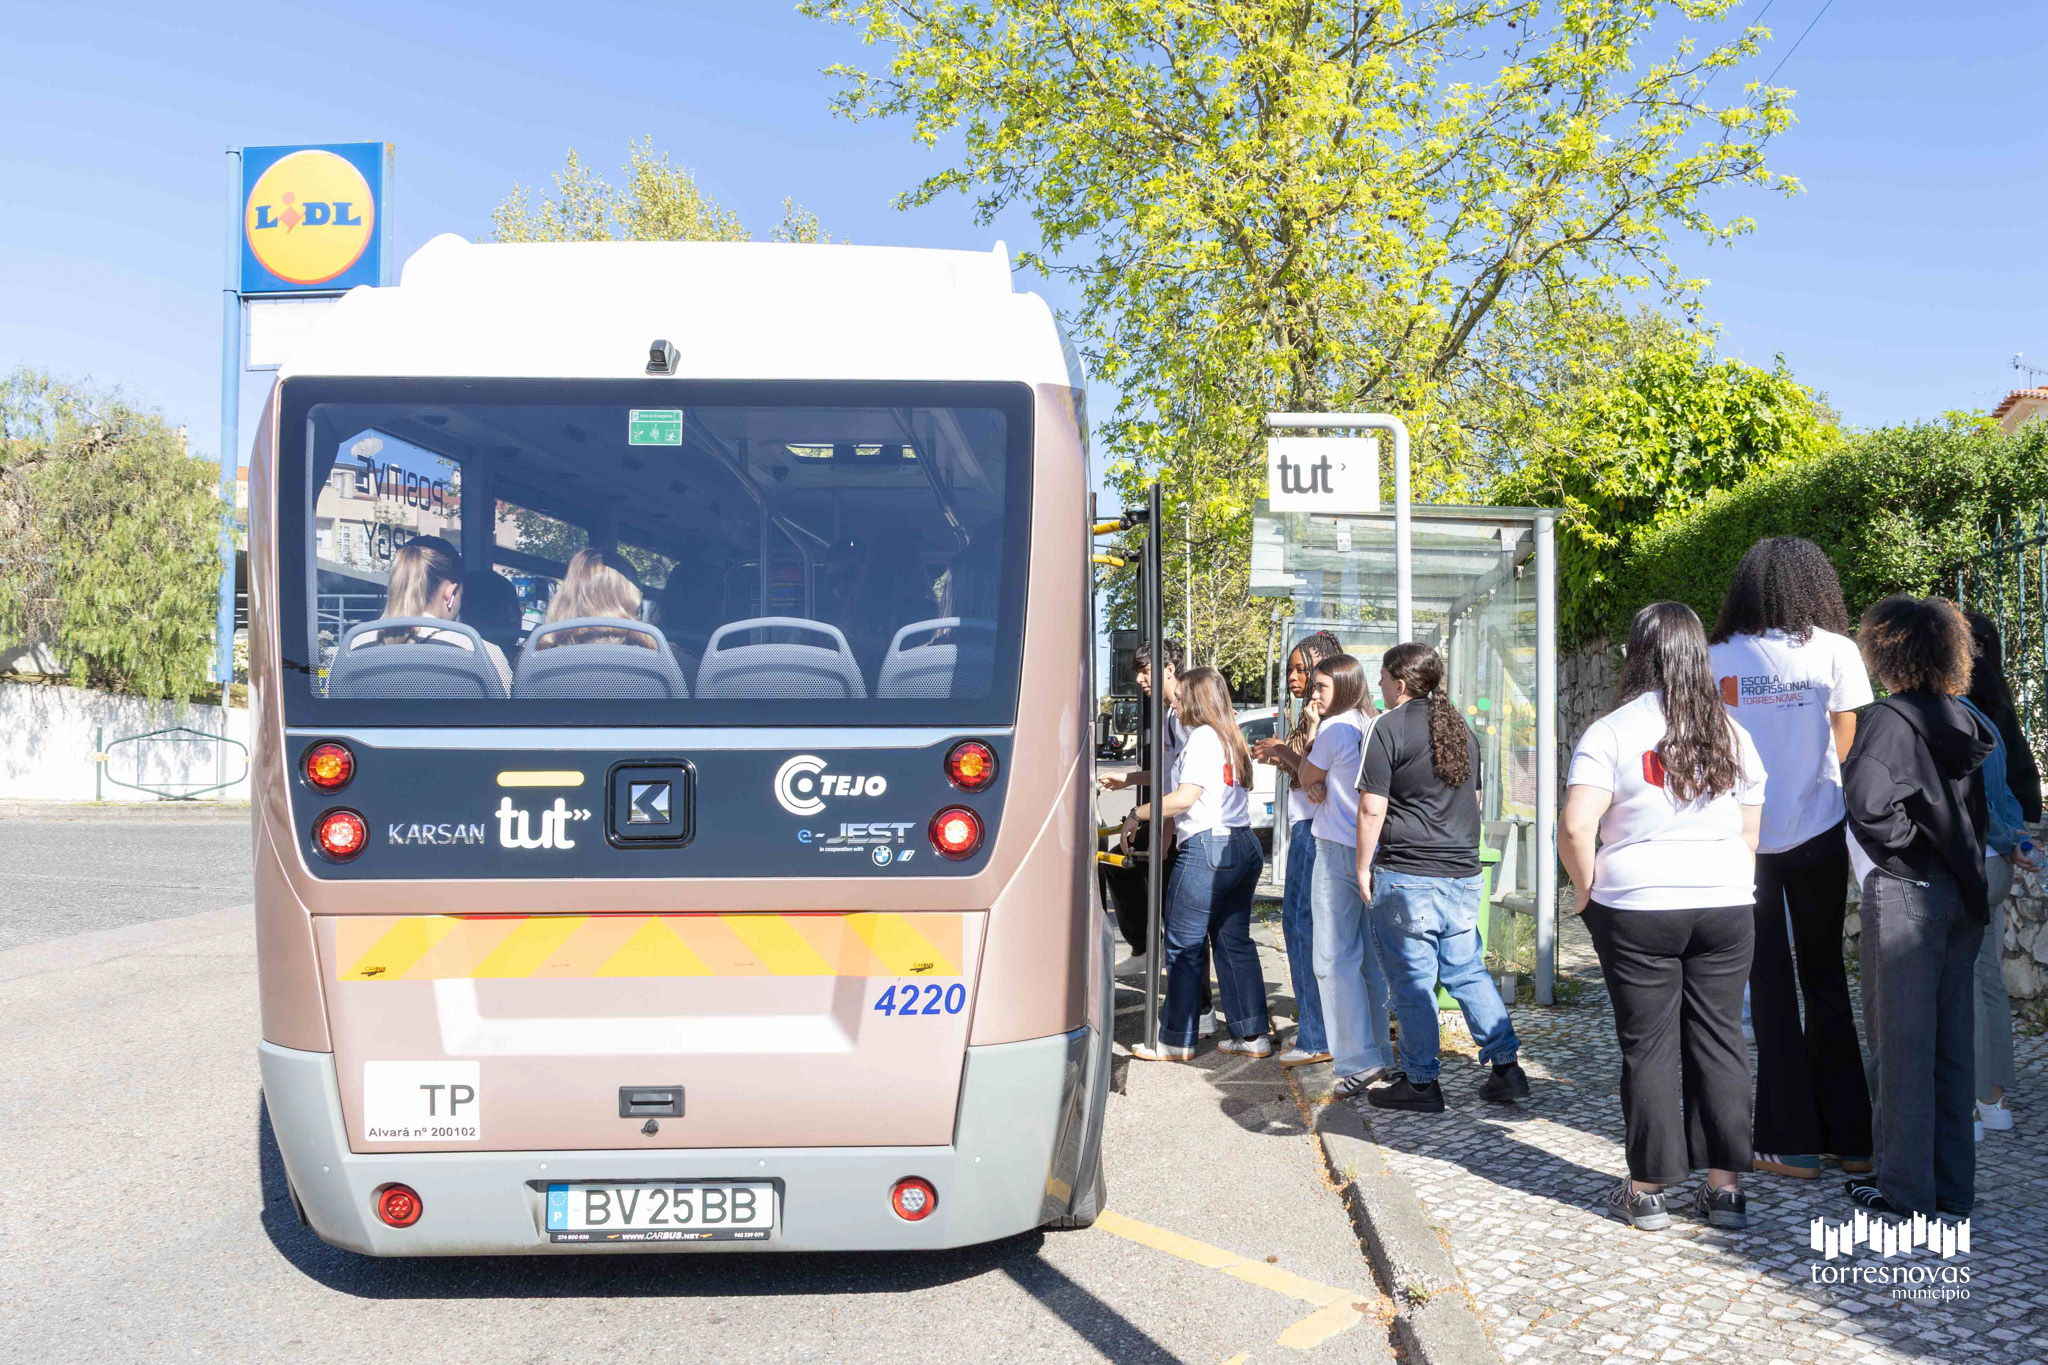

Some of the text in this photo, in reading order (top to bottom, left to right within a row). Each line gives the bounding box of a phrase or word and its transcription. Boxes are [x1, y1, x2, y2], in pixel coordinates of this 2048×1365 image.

[1276, 454, 1334, 495] tut
[1741, 674, 1780, 687] ESCOLA
[1741, 680, 1813, 696] PROFISSIONAL
[1742, 692, 1804, 705] TORRES NOVAS
[819, 775, 887, 797] TEJO
[388, 822, 485, 845] KARSAN
[494, 796, 576, 850] tut
[874, 983, 966, 1016] 4220
[420, 1084, 475, 1116] TP
[368, 1127, 410, 1137] Alvará
[431, 1127, 476, 1137] 200102
[553, 1211, 562, 1223] P
